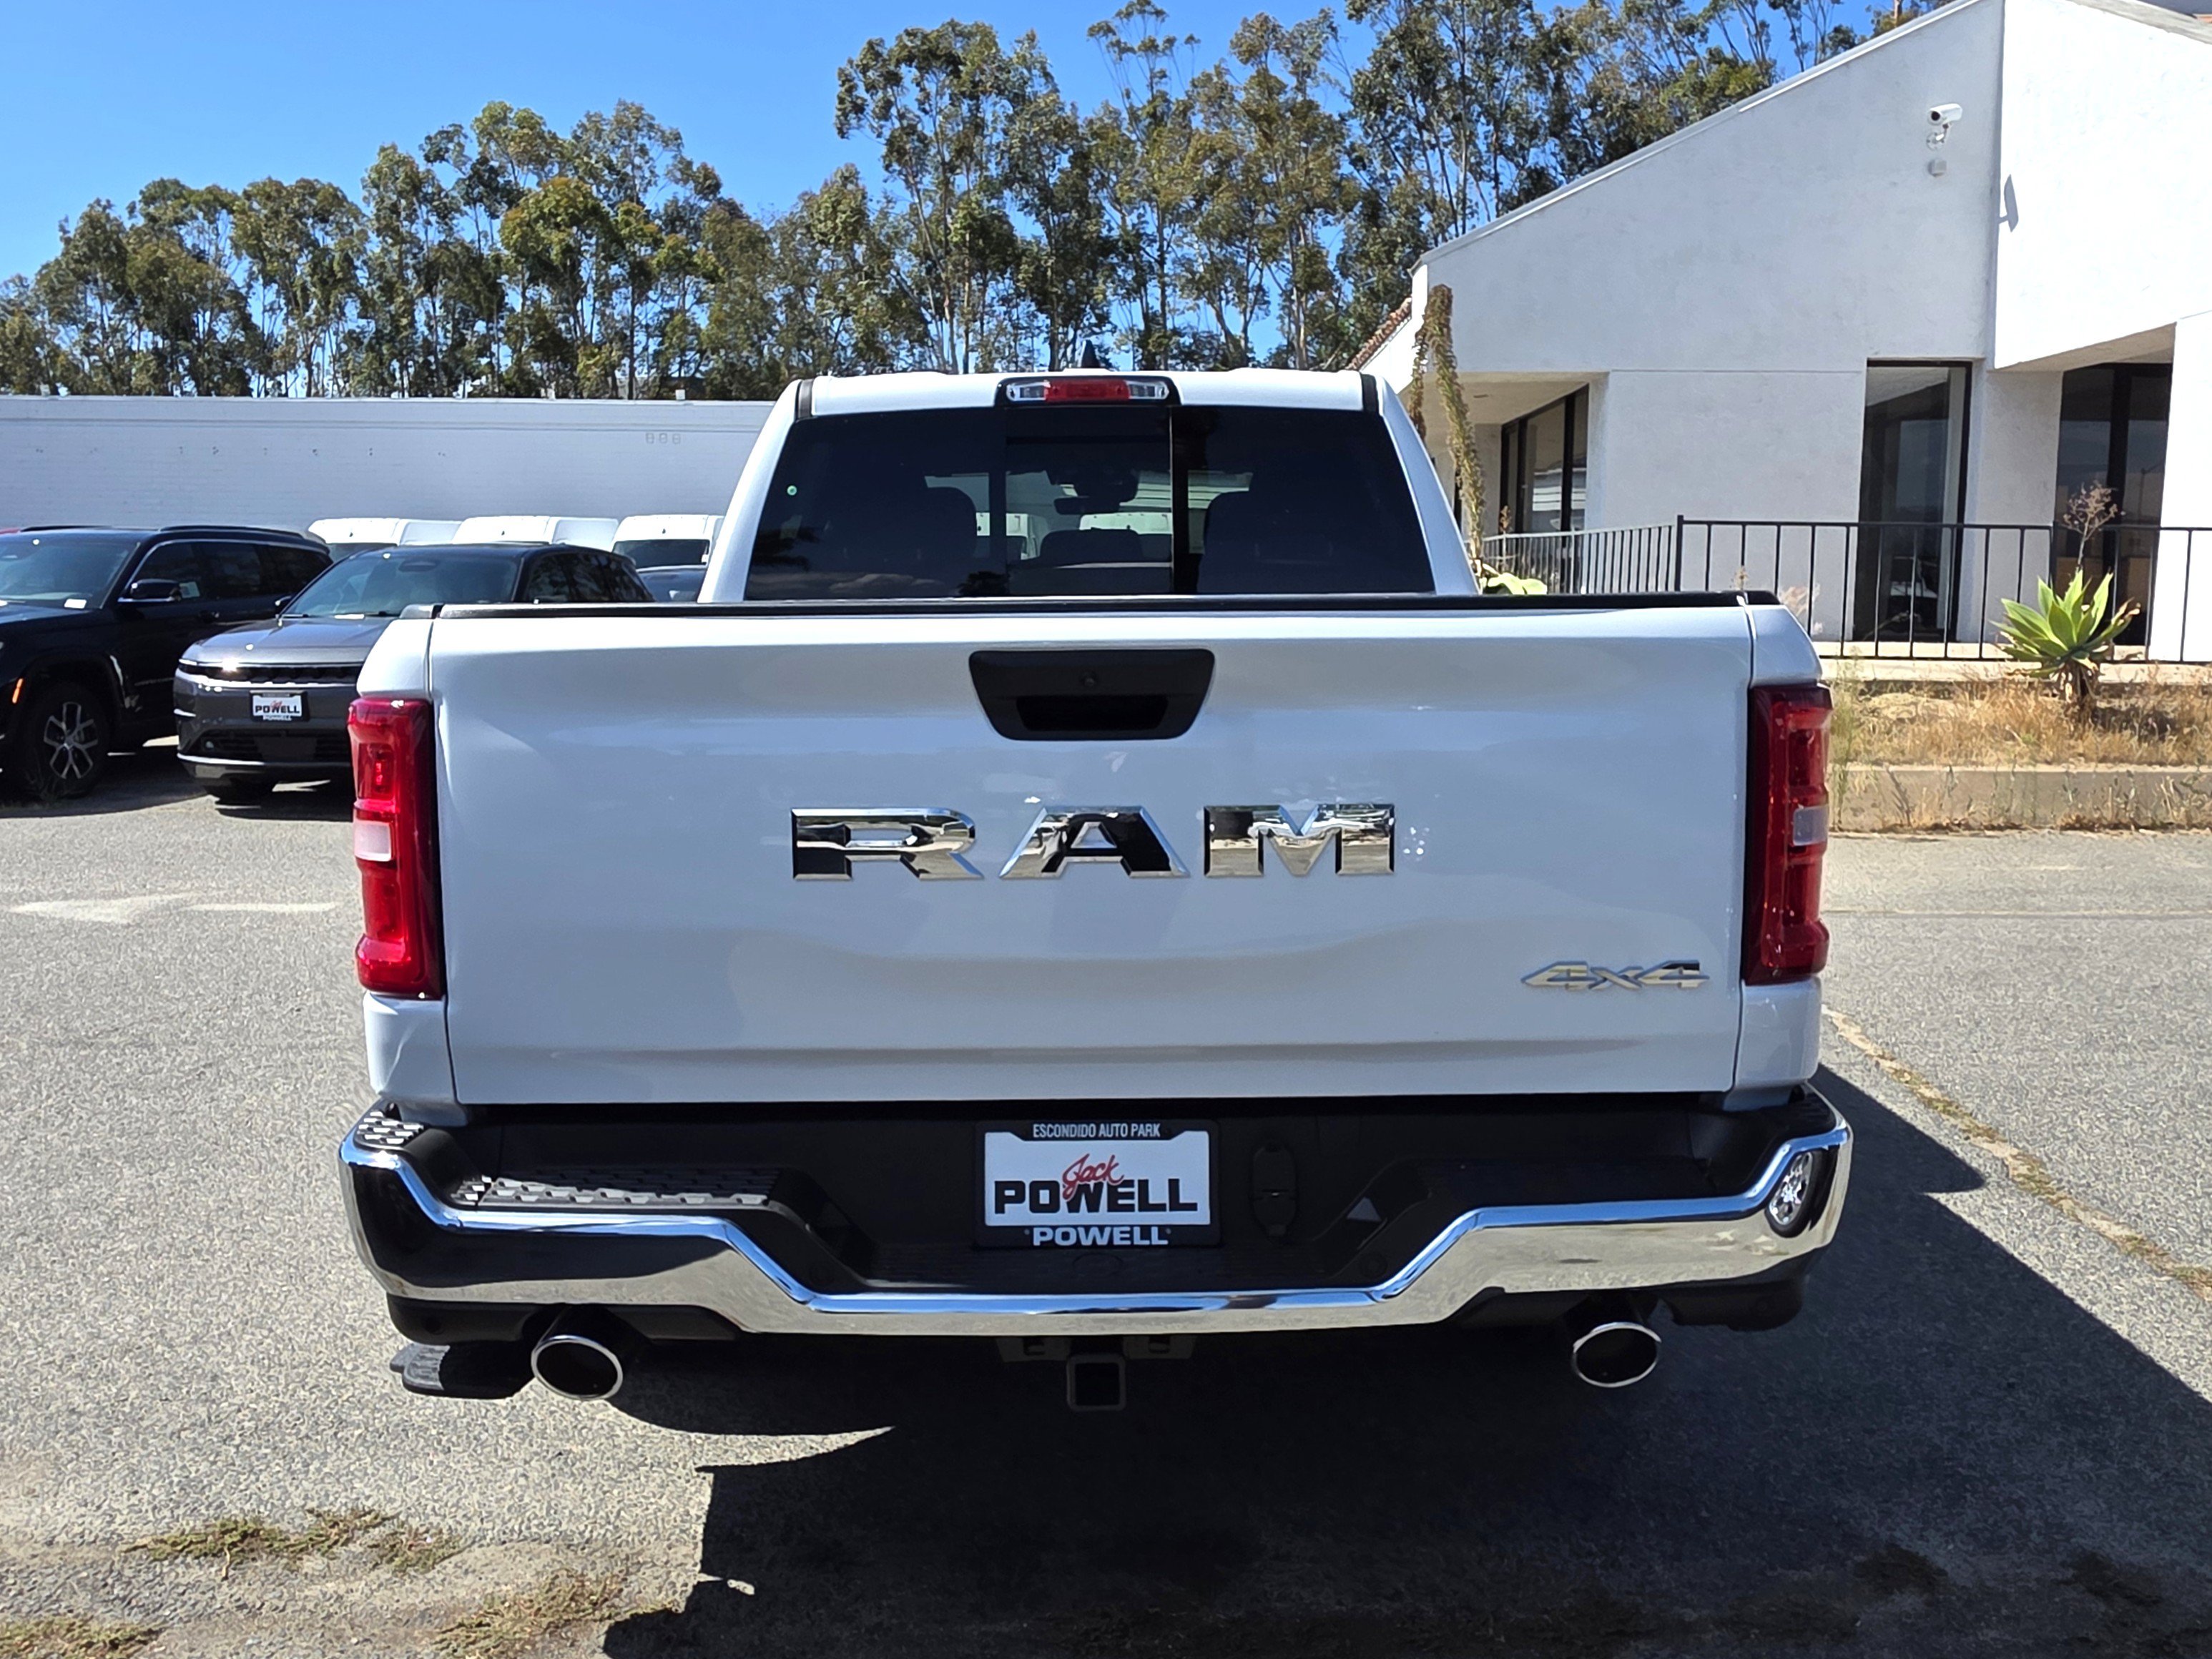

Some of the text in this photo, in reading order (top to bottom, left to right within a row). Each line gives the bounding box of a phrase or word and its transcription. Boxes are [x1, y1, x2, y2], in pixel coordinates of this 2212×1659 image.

[255, 705, 300, 714] POWELL
[791, 804, 1395, 881] RAM
[1033, 1123, 1161, 1138] ESCONDIDO AUTO PARK
[1062, 1153, 1125, 1201] Jack
[994, 1178, 1198, 1214] POWELL
[1033, 1226, 1169, 1246] POWELL
